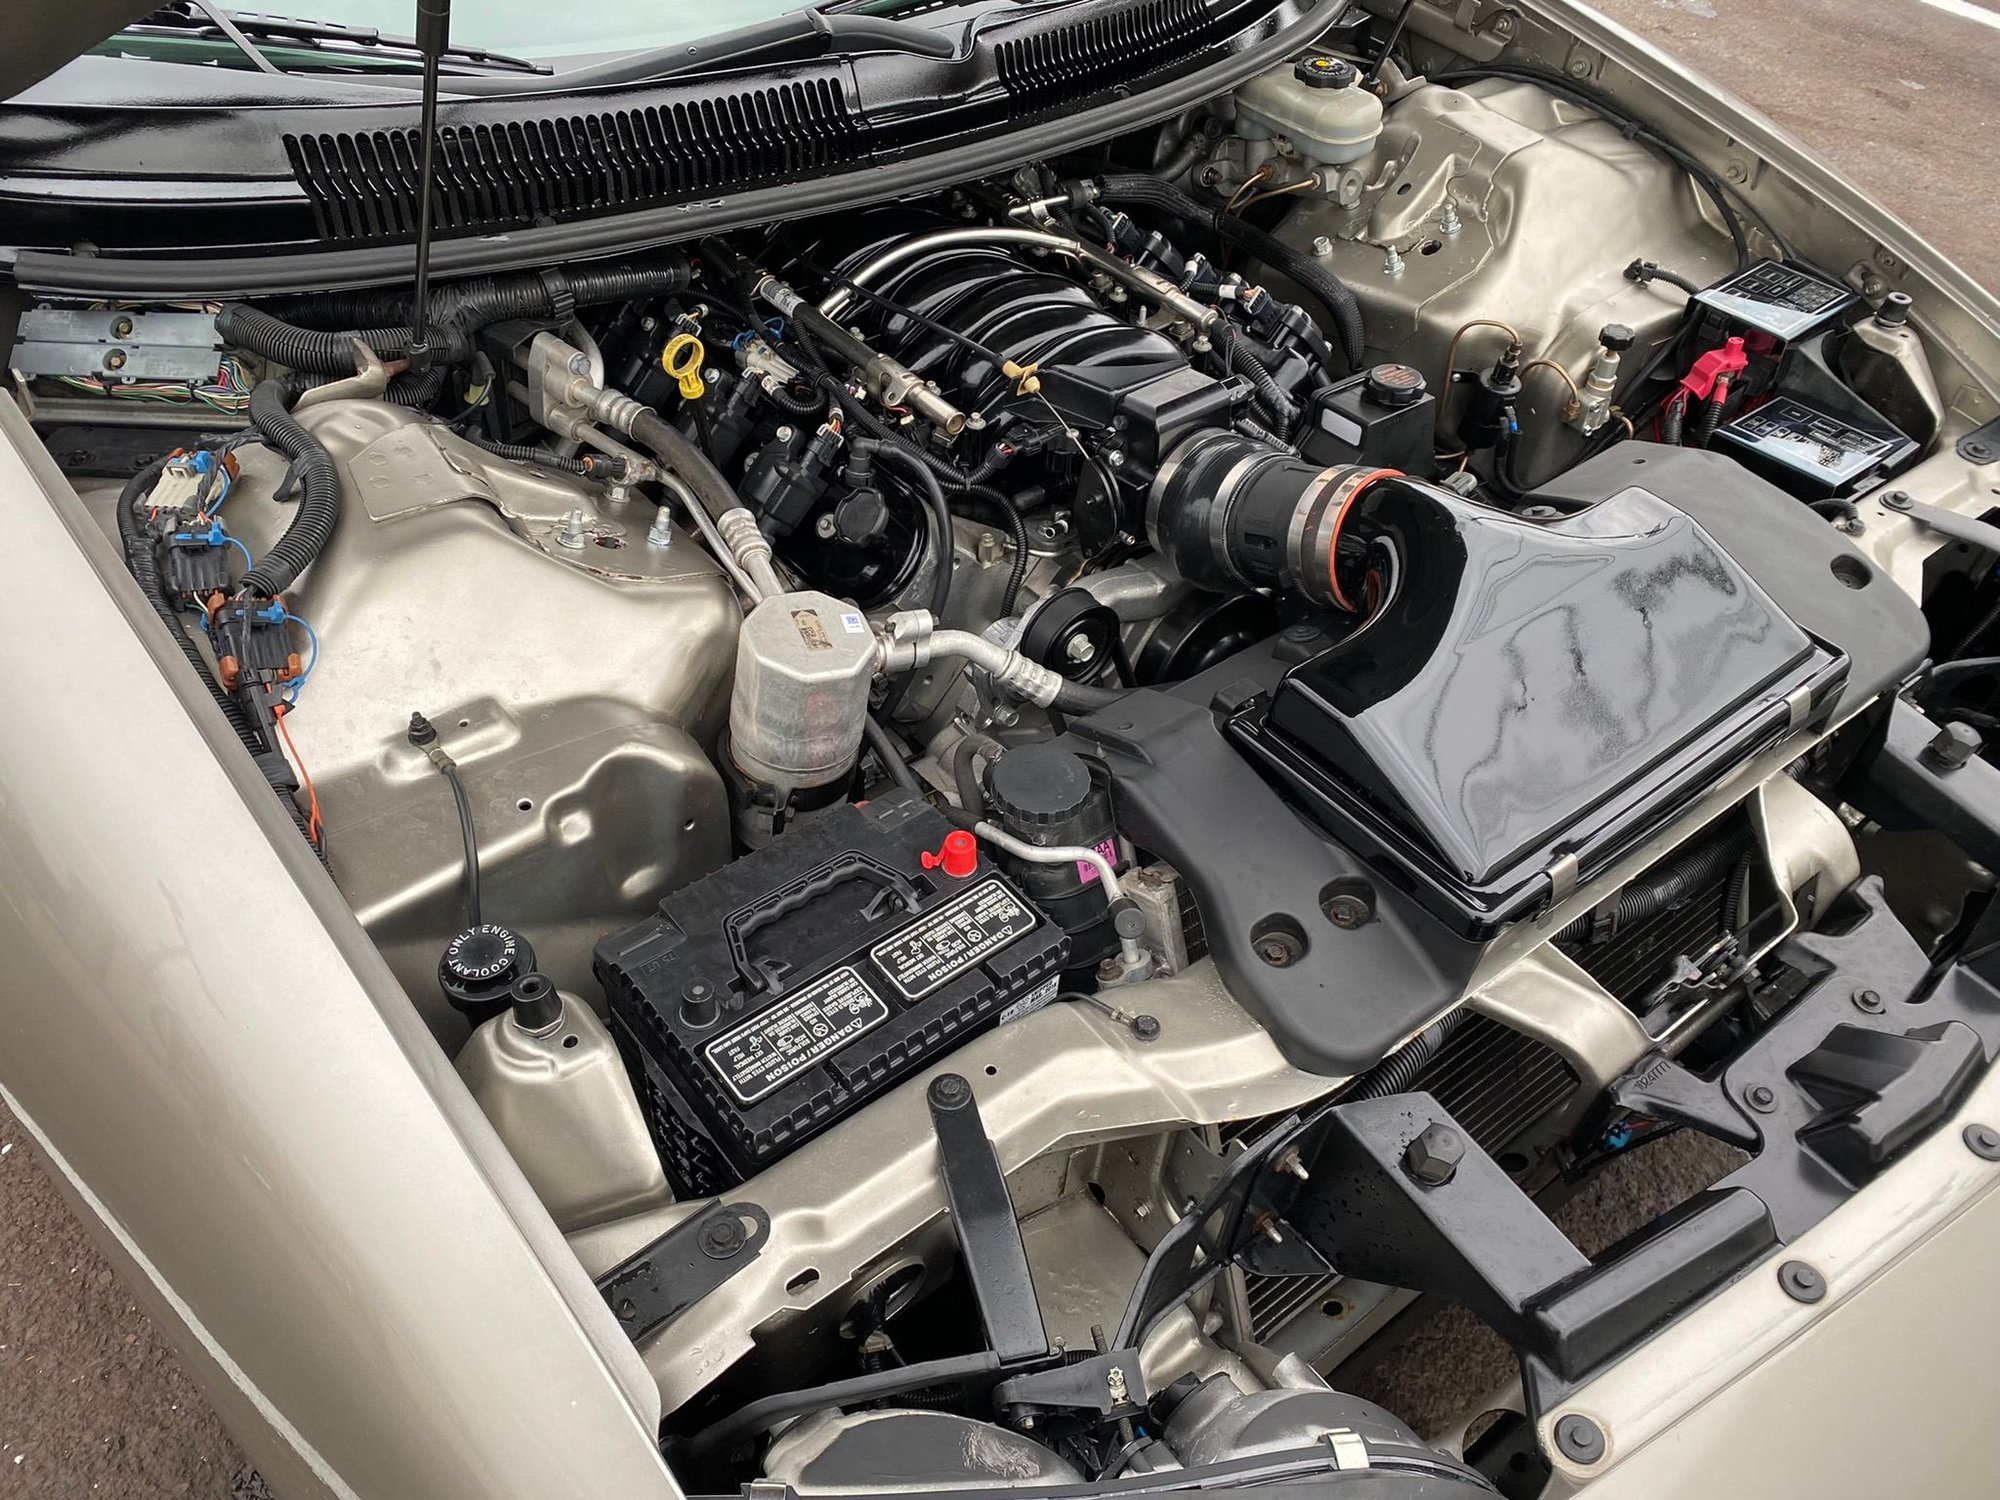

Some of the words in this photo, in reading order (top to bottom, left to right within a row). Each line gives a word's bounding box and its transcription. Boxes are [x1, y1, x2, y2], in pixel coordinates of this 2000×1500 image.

[449, 927, 475, 955] ONLY
[482, 925, 515, 955] ENGINE
[448, 958, 509, 977] COOLANT
[763, 1024, 854, 1081] DANGER/POISON
